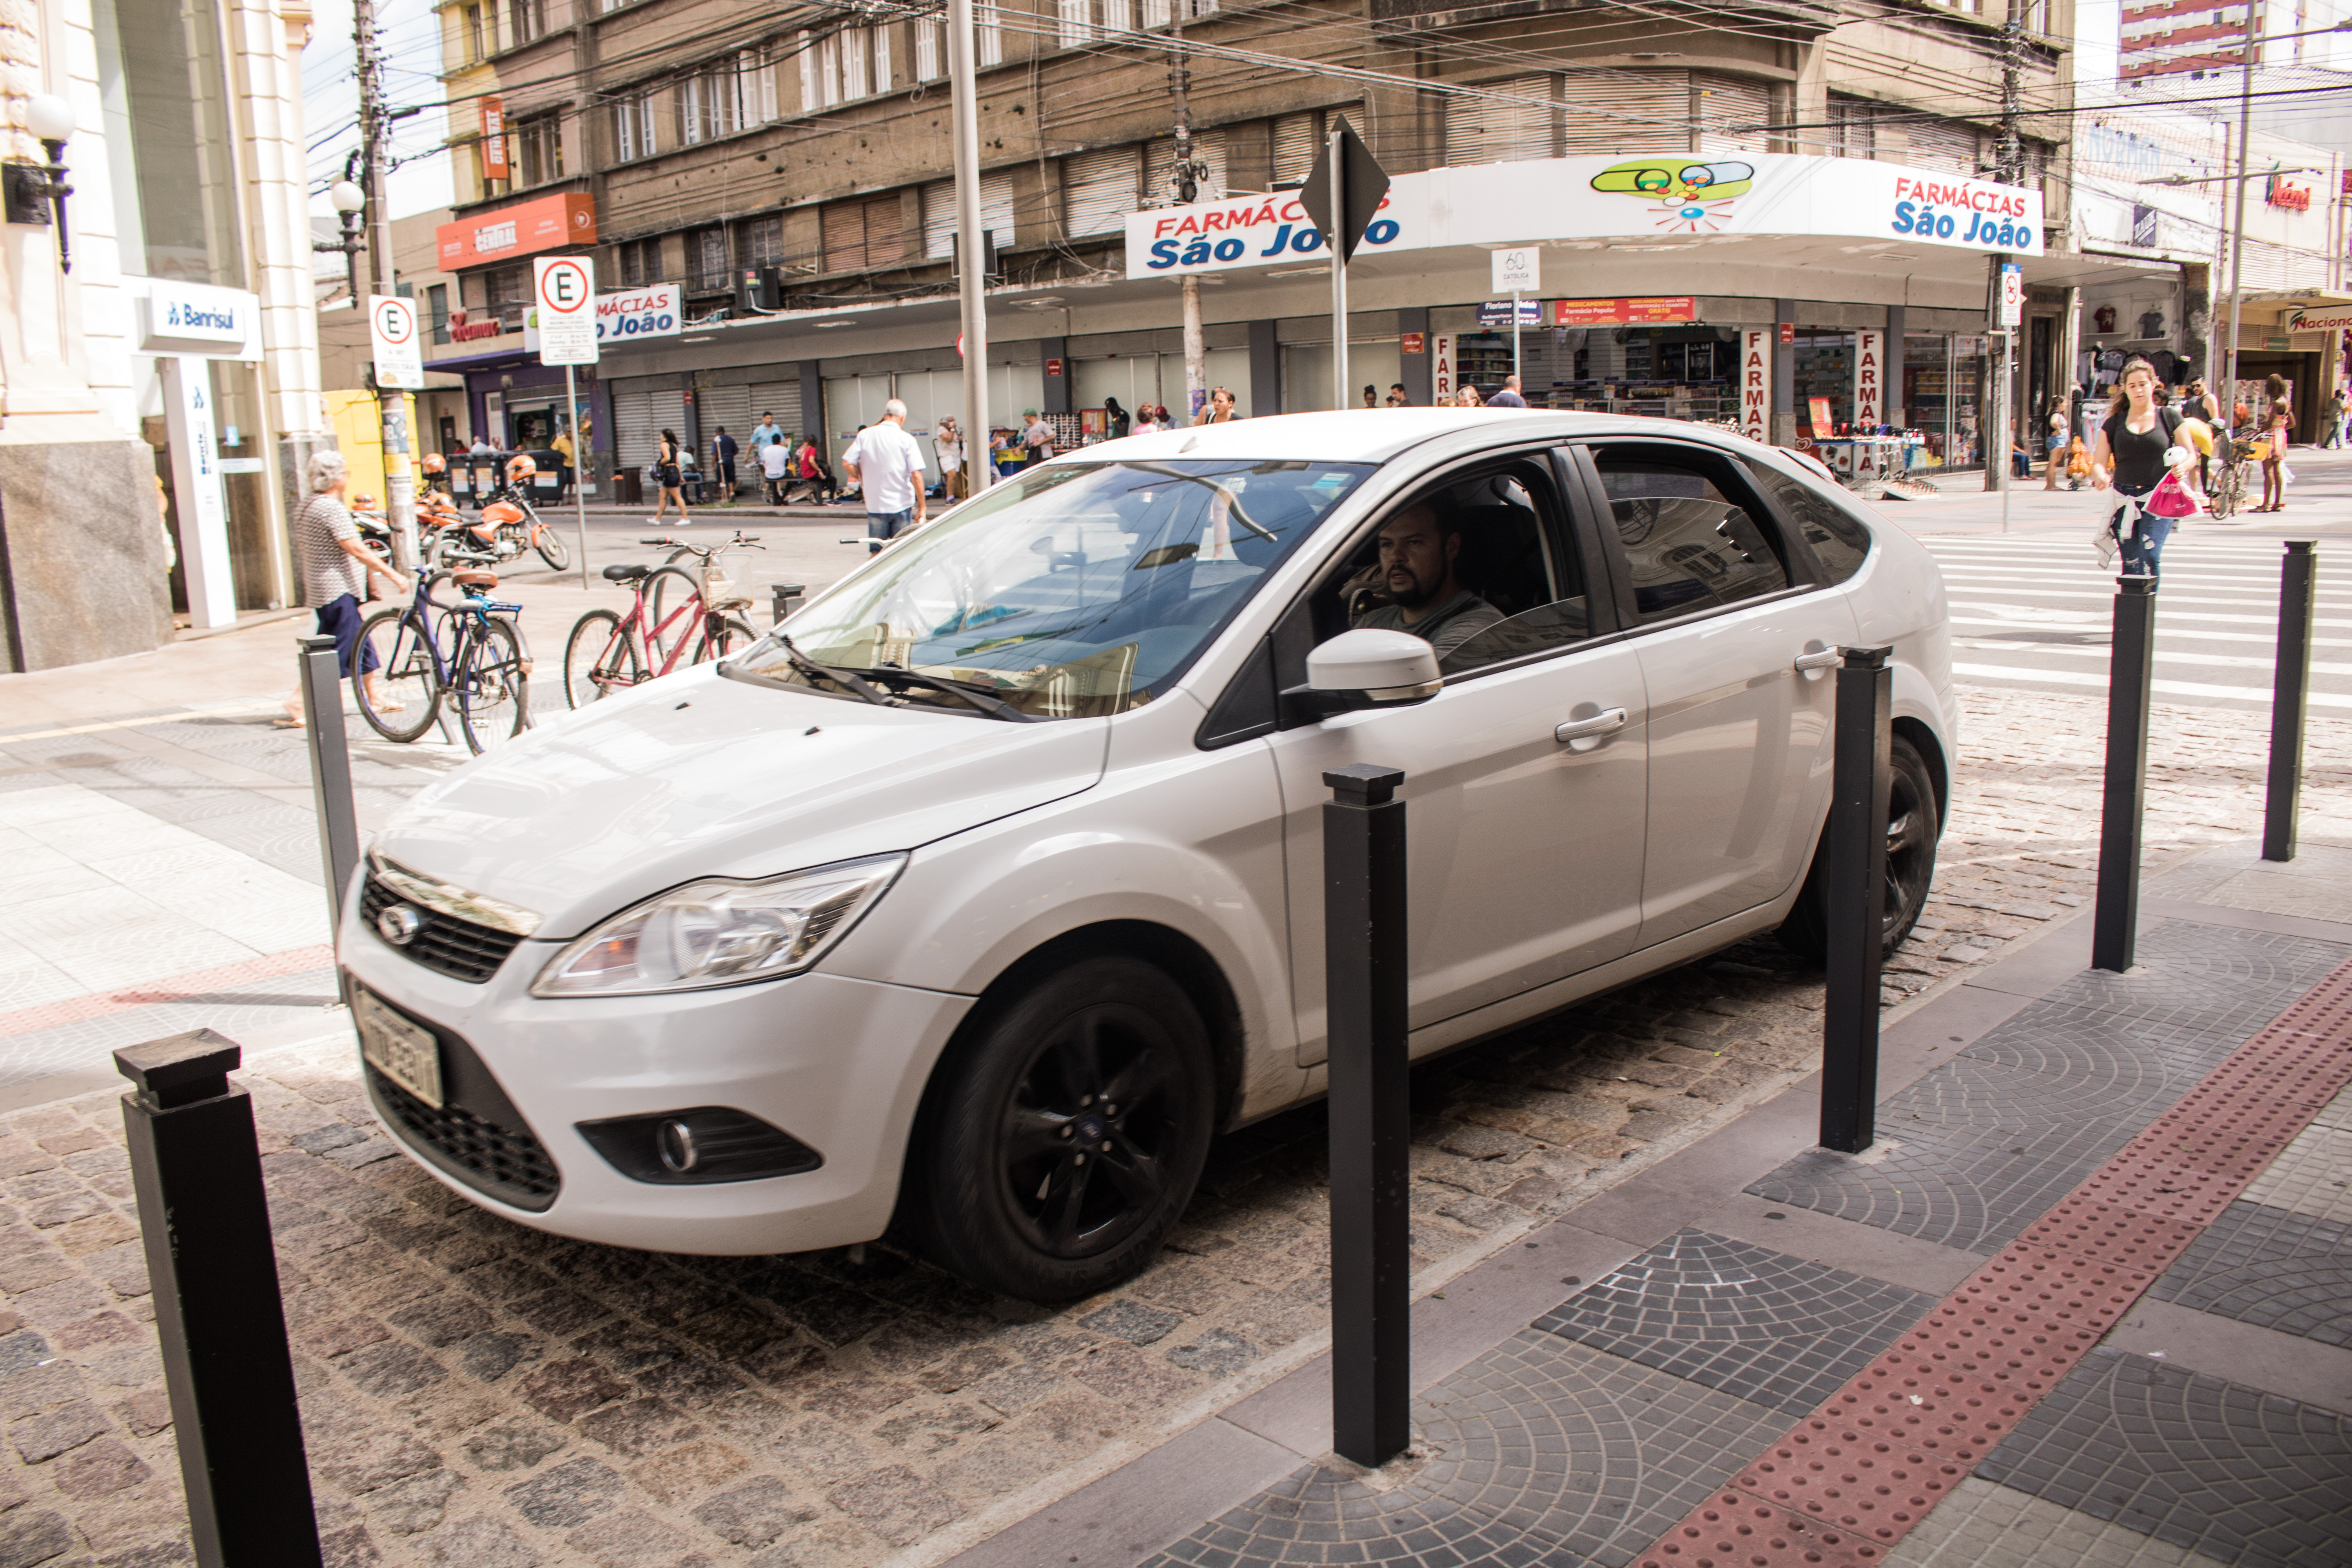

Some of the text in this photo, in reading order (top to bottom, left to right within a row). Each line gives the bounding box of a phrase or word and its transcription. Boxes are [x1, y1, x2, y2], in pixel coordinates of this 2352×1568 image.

[486, 109, 504, 164] CENTRAL
[1896, 178, 2025, 217] FARMÁCIAS
[474, 220, 517, 252] CENTRAL
[1892, 201, 2031, 248] São João
[1147, 220, 1399, 269] São Joo
[556, 272, 573, 301] E
[184, 303, 233, 329] Banrisul
[387, 310, 400, 334] E
[596, 294, 668, 318] MÁCIAS
[1485, 302, 1513, 310] Floriano
[612, 310, 673, 336] João
[1746, 332, 1764, 442] FARMÁC
[1859, 335, 1877, 471] FARMÁIA
